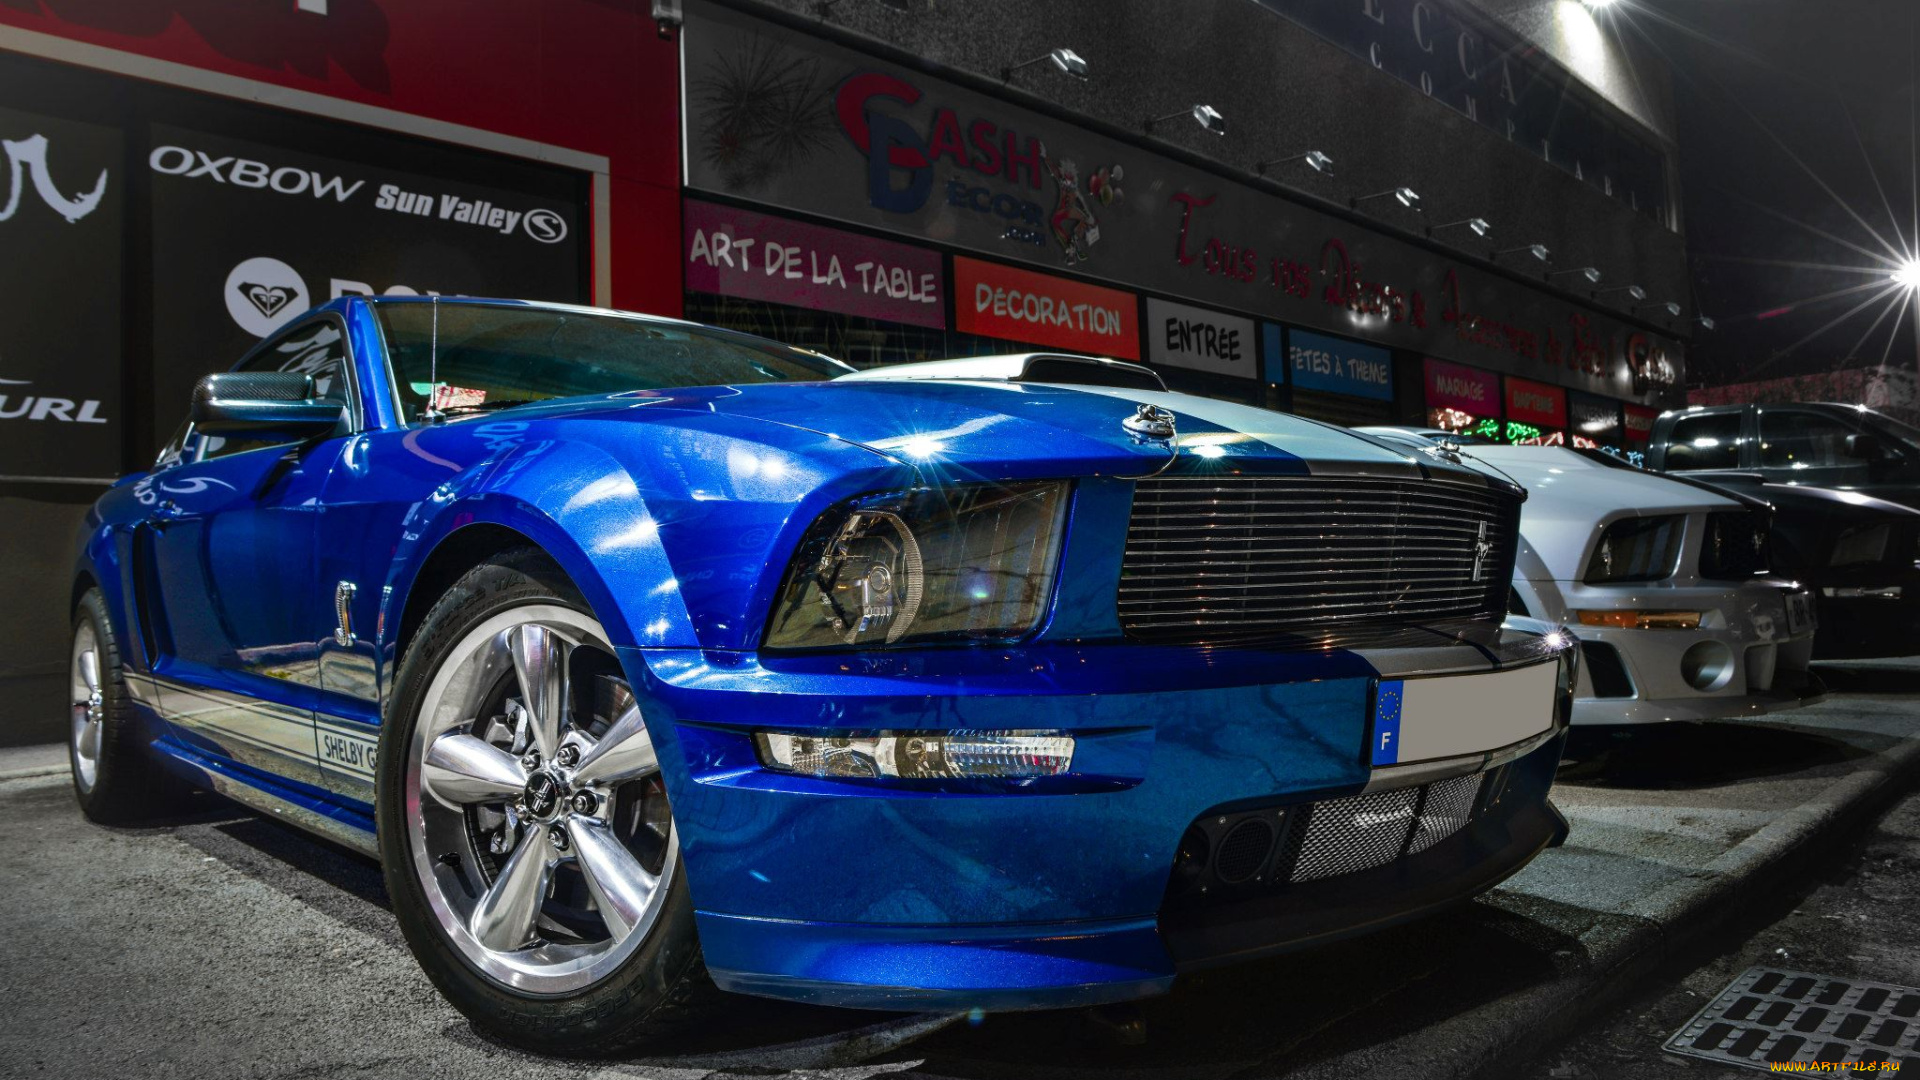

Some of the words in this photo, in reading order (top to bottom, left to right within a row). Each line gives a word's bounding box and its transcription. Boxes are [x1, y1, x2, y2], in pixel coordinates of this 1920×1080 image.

[149, 146, 365, 202] OXBOW
[375, 184, 434, 217] Sun
[439, 194, 522, 234] Valley
[690, 229, 755, 272] ART
[764, 242, 803, 276] DE
[811, 250, 846, 289] LA
[855, 262, 937, 303] TABLE
[976, 283, 1120, 336] DÉCORATION
[1166, 318, 1240, 361] ENTRÉE
[1289, 346, 1331, 375] FÊTES
[1334, 355, 1343, 377] À
[1436, 374, 1485, 401] MARIAGE
[324, 734, 364, 767] SHELBY
[366, 746, 379, 771] G
[1381, 732, 1391, 750] F
